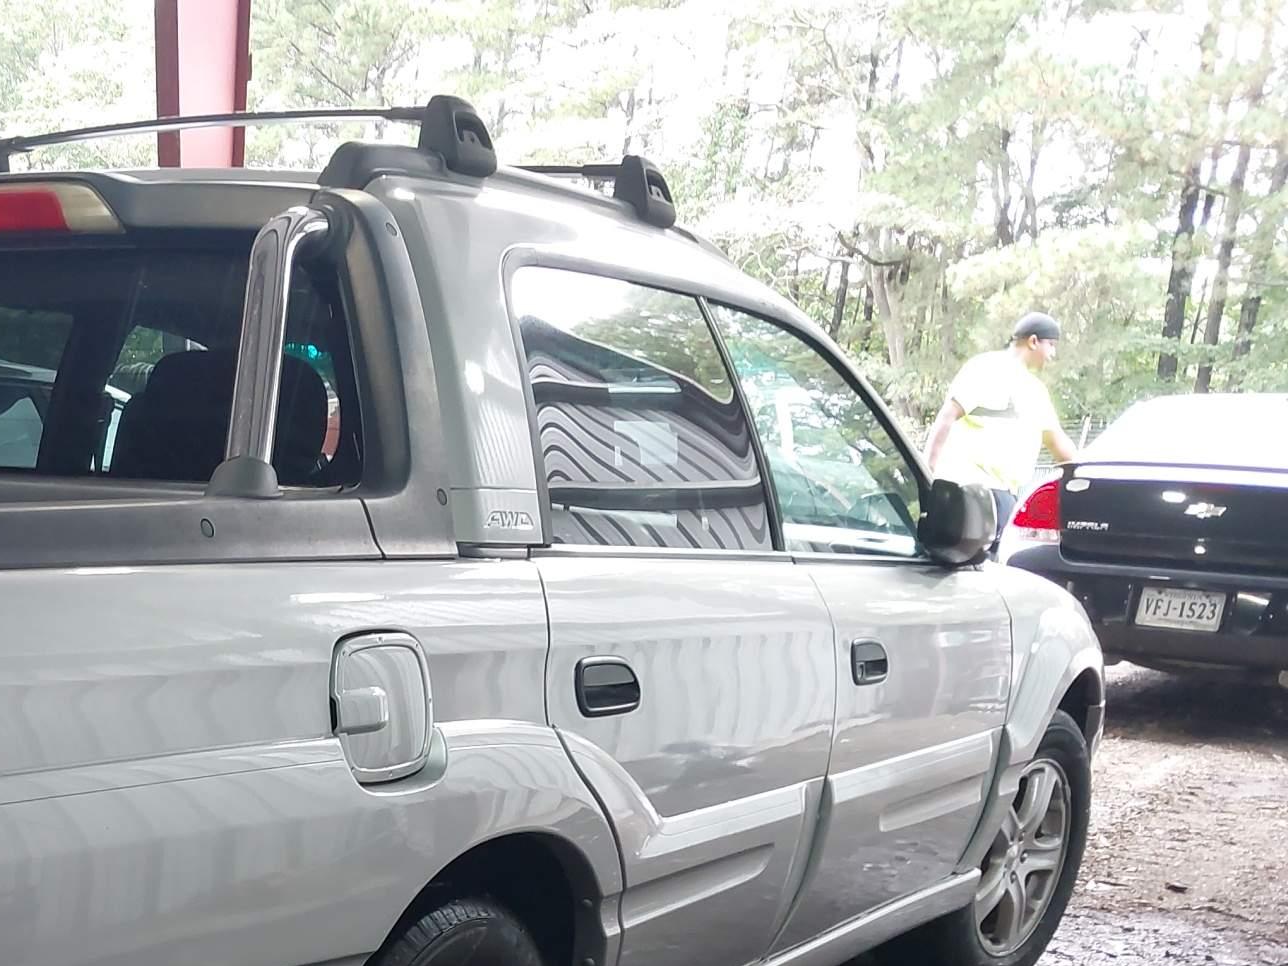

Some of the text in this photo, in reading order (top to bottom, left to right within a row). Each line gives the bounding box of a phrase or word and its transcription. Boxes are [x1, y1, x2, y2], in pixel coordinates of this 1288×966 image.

[486, 510, 535, 528] AWD
[1066, 520, 1110, 531] IMPALA
[1144, 597, 1217, 621] VFJ-1523
